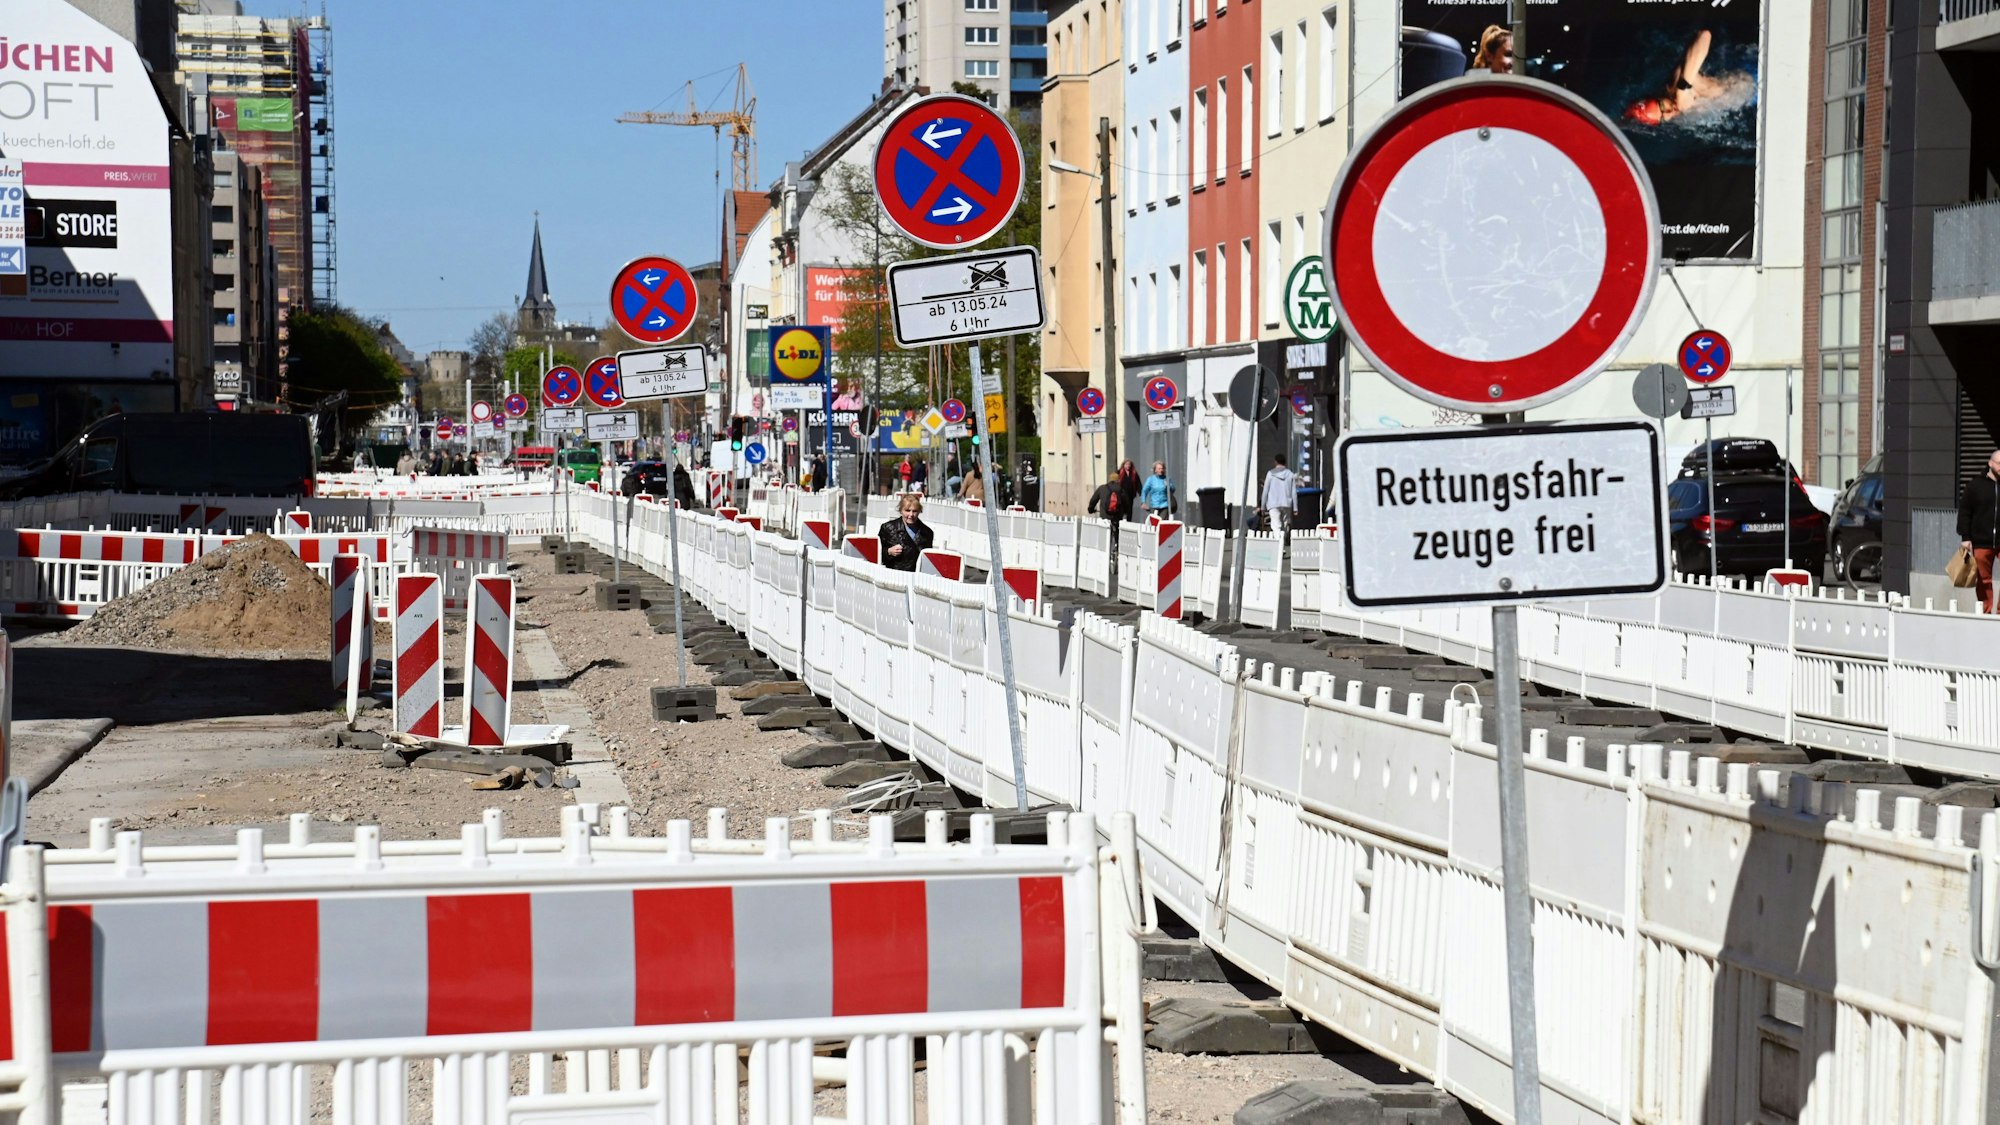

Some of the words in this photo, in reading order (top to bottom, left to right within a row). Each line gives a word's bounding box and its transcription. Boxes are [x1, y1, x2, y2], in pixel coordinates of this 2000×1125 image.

[56, 213, 117, 236] STORE
[30, 265, 118, 287] Berner
[815, 290, 833, 301] für
[929, 304, 945, 316] ab
[952, 295, 1008, 314] 13.05.24
[950, 319, 958, 332] 6
[964, 317, 990, 330] Uhr
[1298, 302, 1331, 328] M
[36, 322, 73, 337] HOF
[640, 376, 650, 384] ab
[653, 373, 687, 383] 13.05.24
[1376, 458, 1625, 512] Rettungsfahr-
[1413, 528, 1515, 568] zeuge
[1535, 513, 1596, 555] frei
